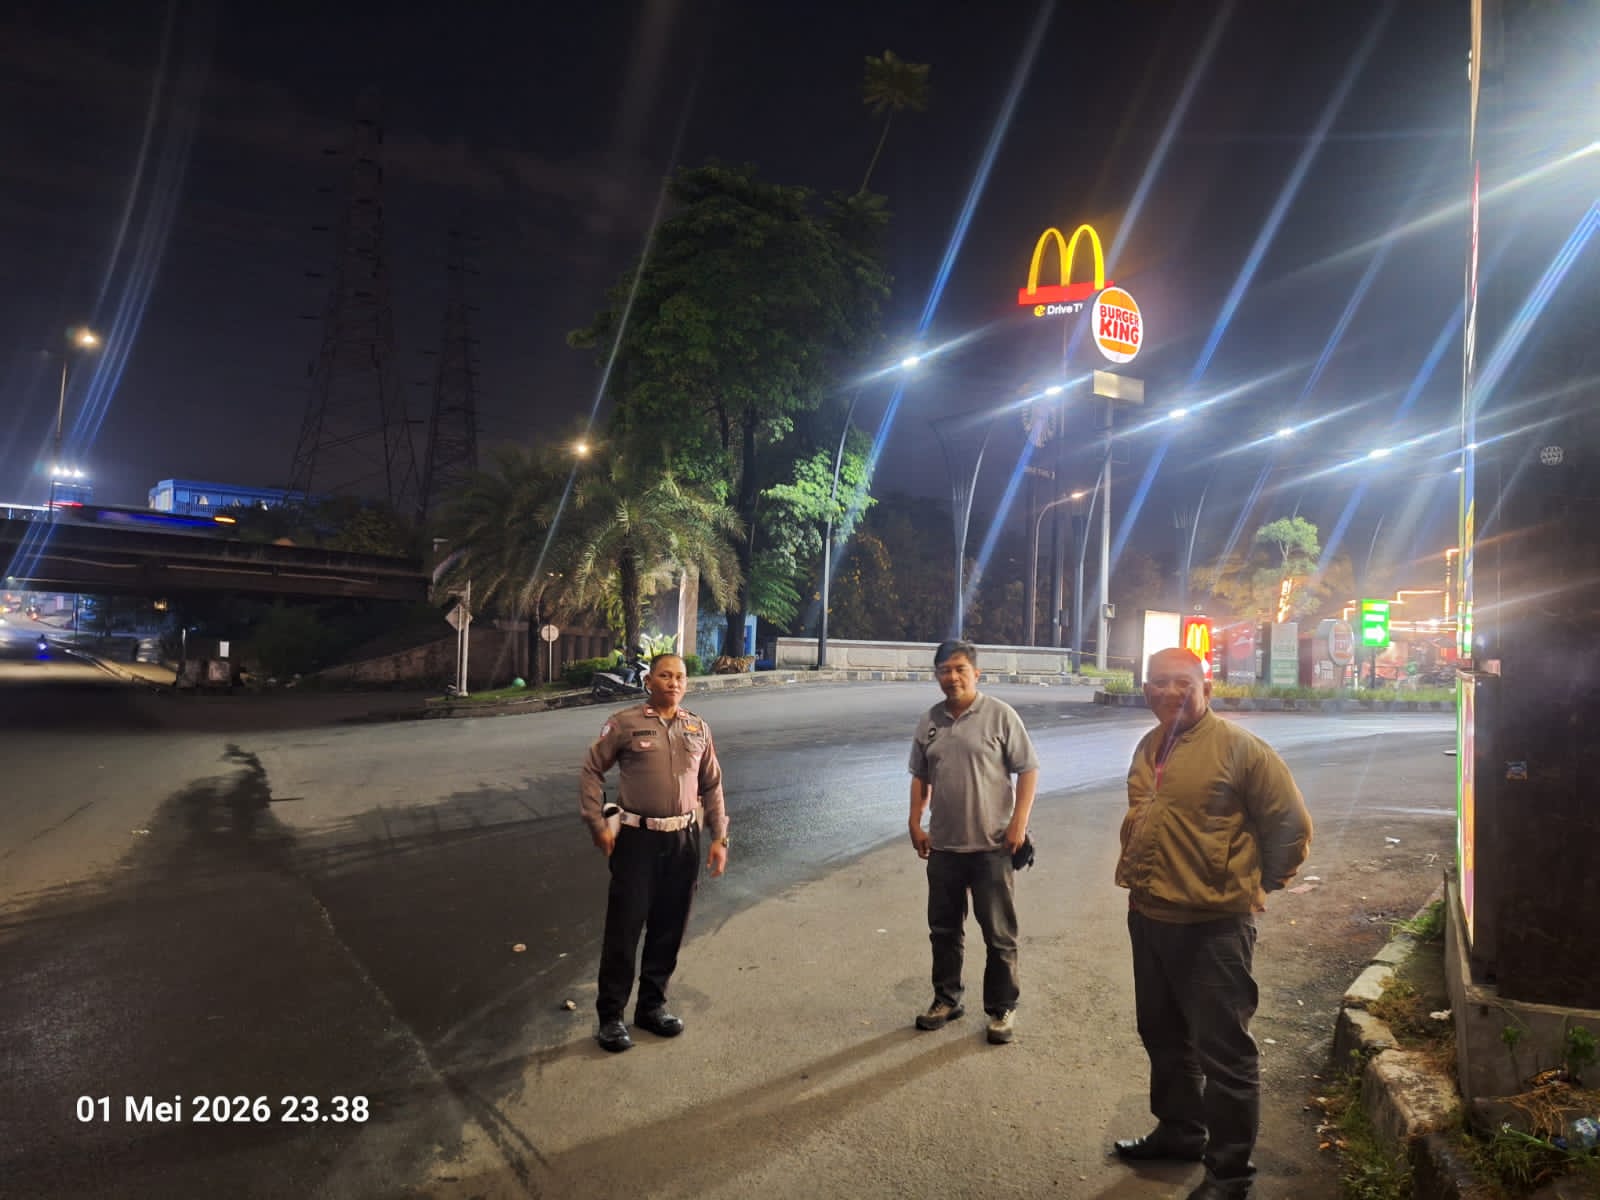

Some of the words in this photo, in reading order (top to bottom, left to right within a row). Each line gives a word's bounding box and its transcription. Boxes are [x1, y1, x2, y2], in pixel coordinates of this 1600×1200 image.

[1047, 304, 1073, 315] Drive
[1099, 305, 1139, 326] BURGER
[1099, 318, 1139, 344] KING
